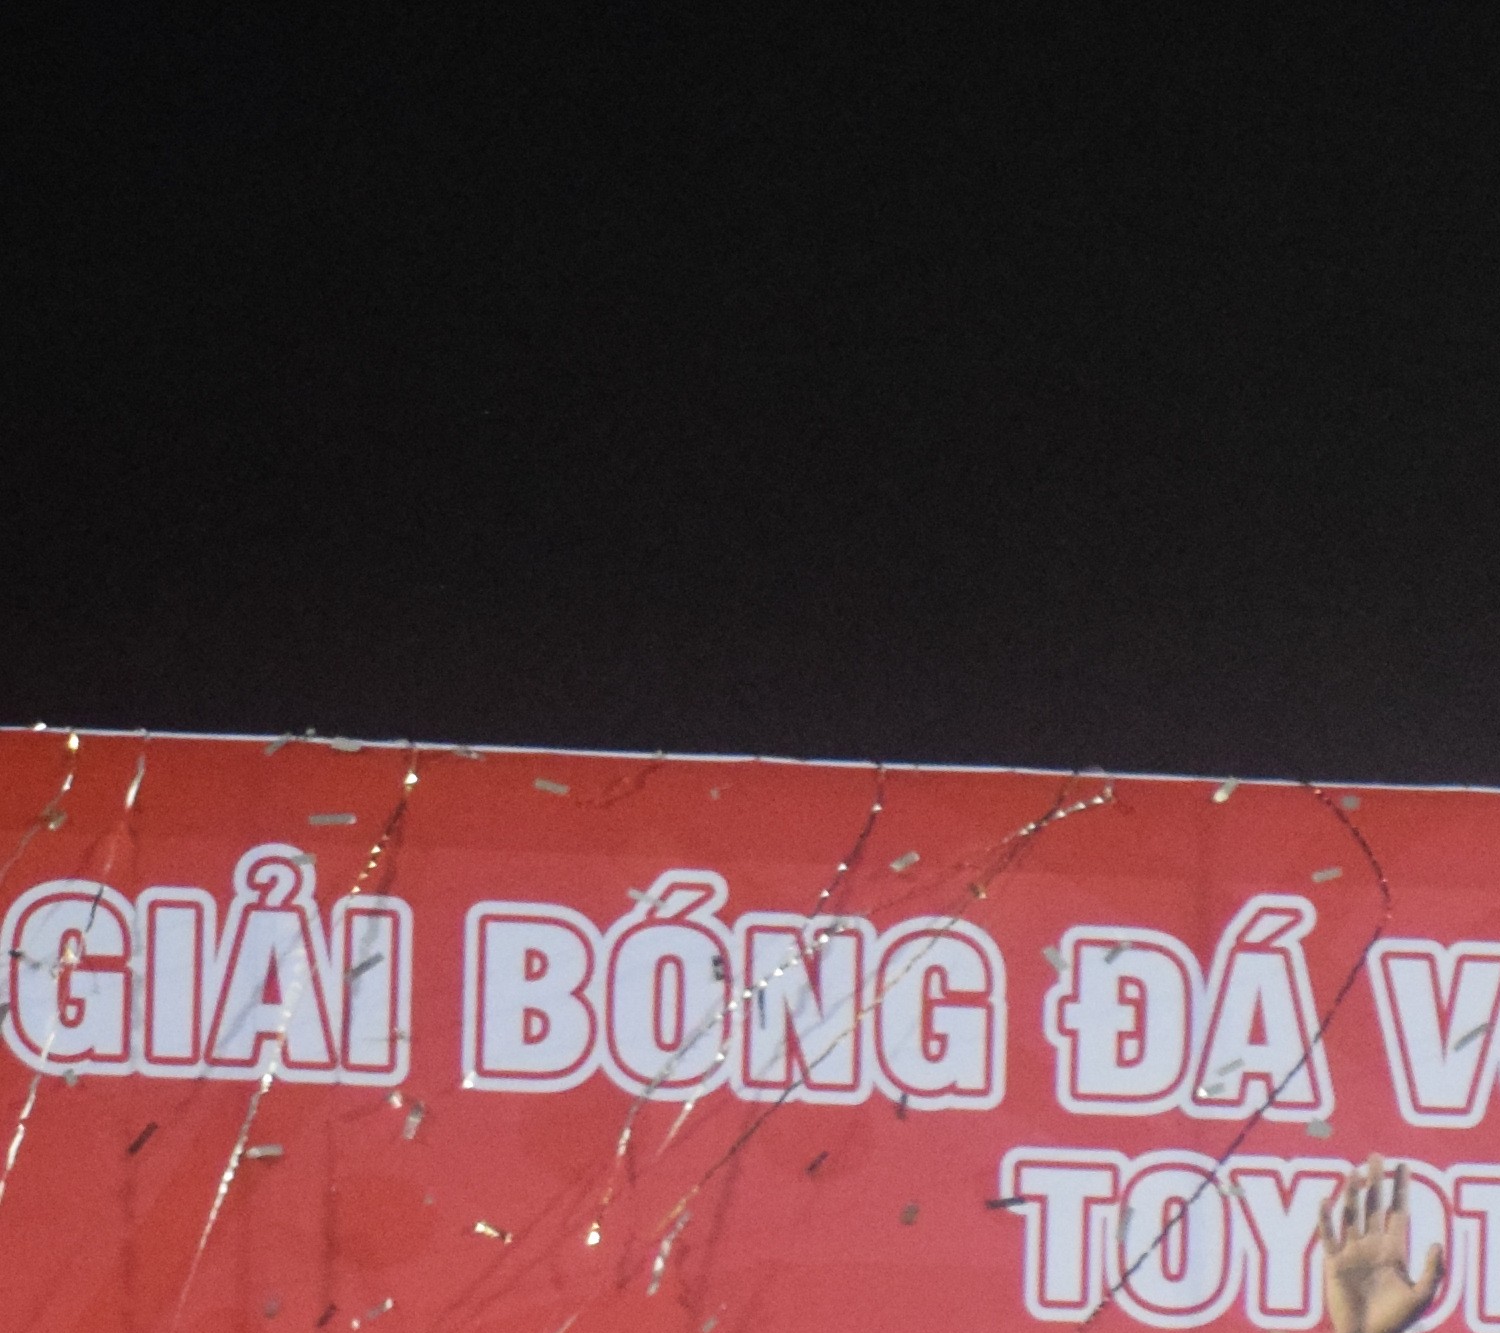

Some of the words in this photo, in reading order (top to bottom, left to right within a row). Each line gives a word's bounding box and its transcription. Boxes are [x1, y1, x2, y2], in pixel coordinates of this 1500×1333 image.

[0, 845, 412, 1085] GIẢI
[464, 870, 1005, 1111] BÓNG
[1044, 894, 1336, 1122] ĐÁ
